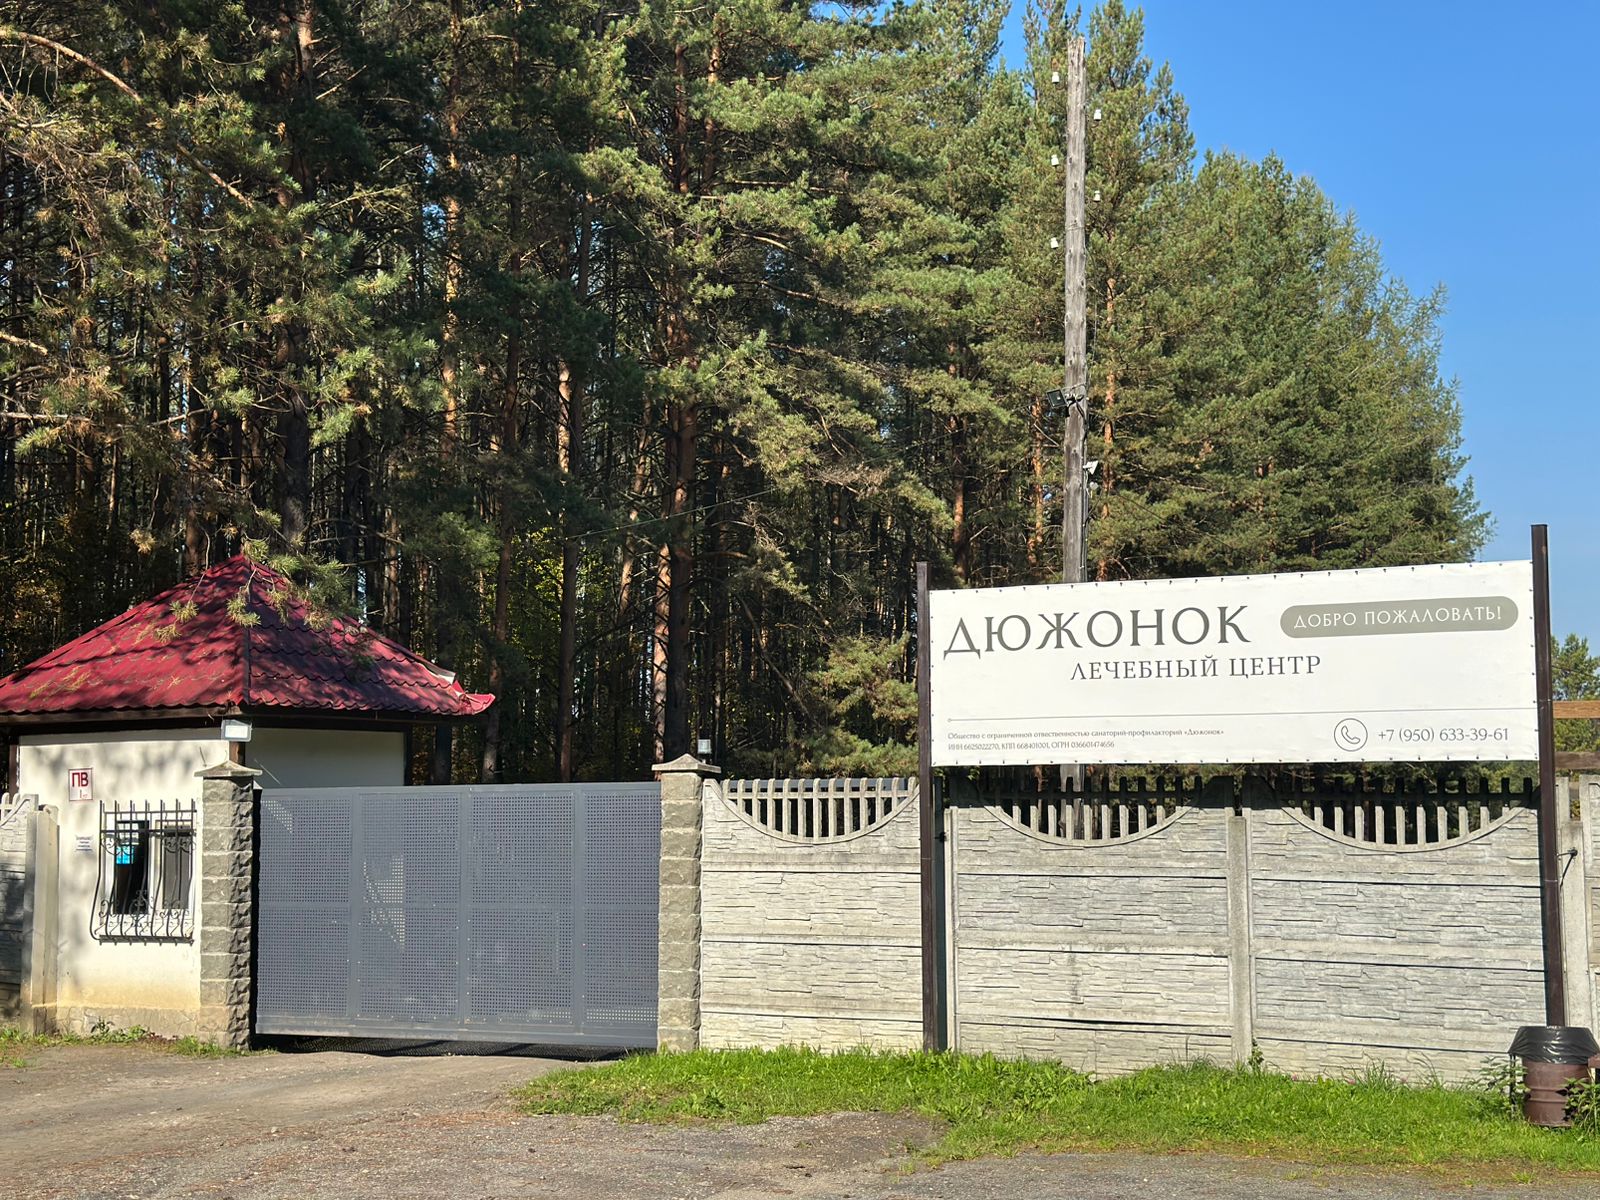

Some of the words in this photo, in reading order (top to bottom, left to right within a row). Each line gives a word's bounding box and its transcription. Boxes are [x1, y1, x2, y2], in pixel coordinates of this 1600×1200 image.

[1294, 612, 1356, 629] ДОБРО
[1364, 606, 1502, 625] ПОЖАЛОВАТЬ!
[943, 605, 1251, 660] ДЮЖОНОК
[1070, 655, 1219, 681] ЛЕЧЕБНЫЙ
[1229, 655, 1321, 679] ЦЕНТР
[1378, 729, 1394, 741] +7
[1399, 727, 1434, 743] (950)
[1439, 728, 1508, 741] 633-39-61
[1001, 742, 1015, 750] КПП
[1051, 740, 1070, 749] ОГРН
[72, 772, 89, 787] ПВ
